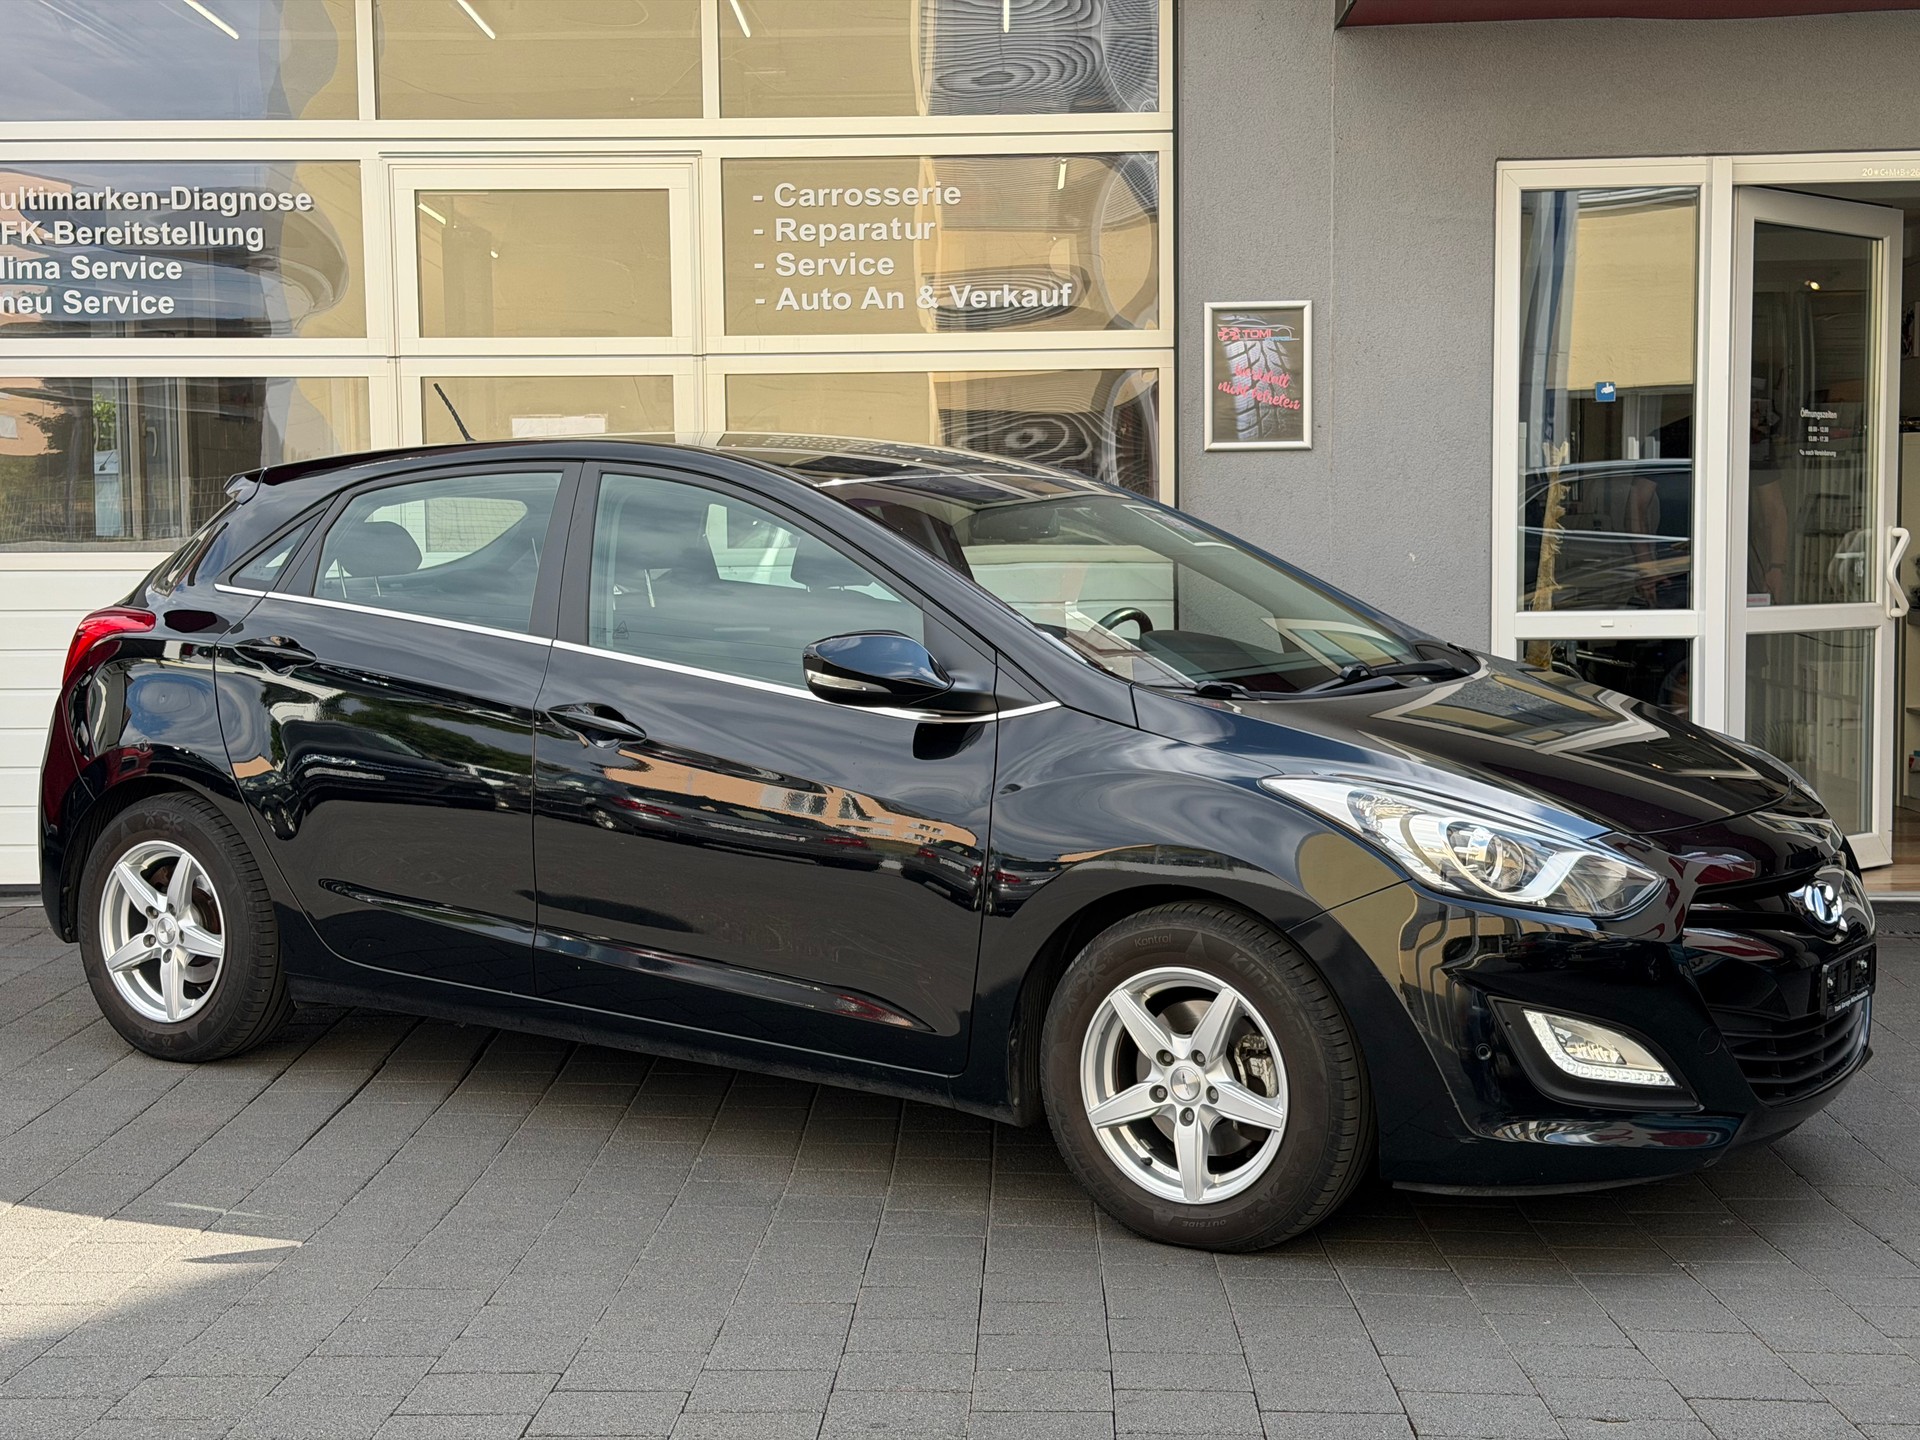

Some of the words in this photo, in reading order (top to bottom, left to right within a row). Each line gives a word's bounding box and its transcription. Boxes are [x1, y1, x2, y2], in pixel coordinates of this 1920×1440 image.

[0, 186, 314, 217] ultimarken-Diagnose
[774, 181, 962, 207] Carrosserie
[1, 221, 266, 252] FK-Bereitstellung
[775, 217, 936, 247] Reparatur
[71, 255, 183, 280] Service
[775, 252, 895, 277] Service
[0, 295, 53, 315] neu
[62, 290, 175, 315] Service
[775, 287, 852, 311] Auto
[860, 286, 904, 311] An
[917, 284, 940, 311] &
[949, 283, 1074, 310] Verkauf
[1181, 1218, 1227, 1228] OUTSIDE
